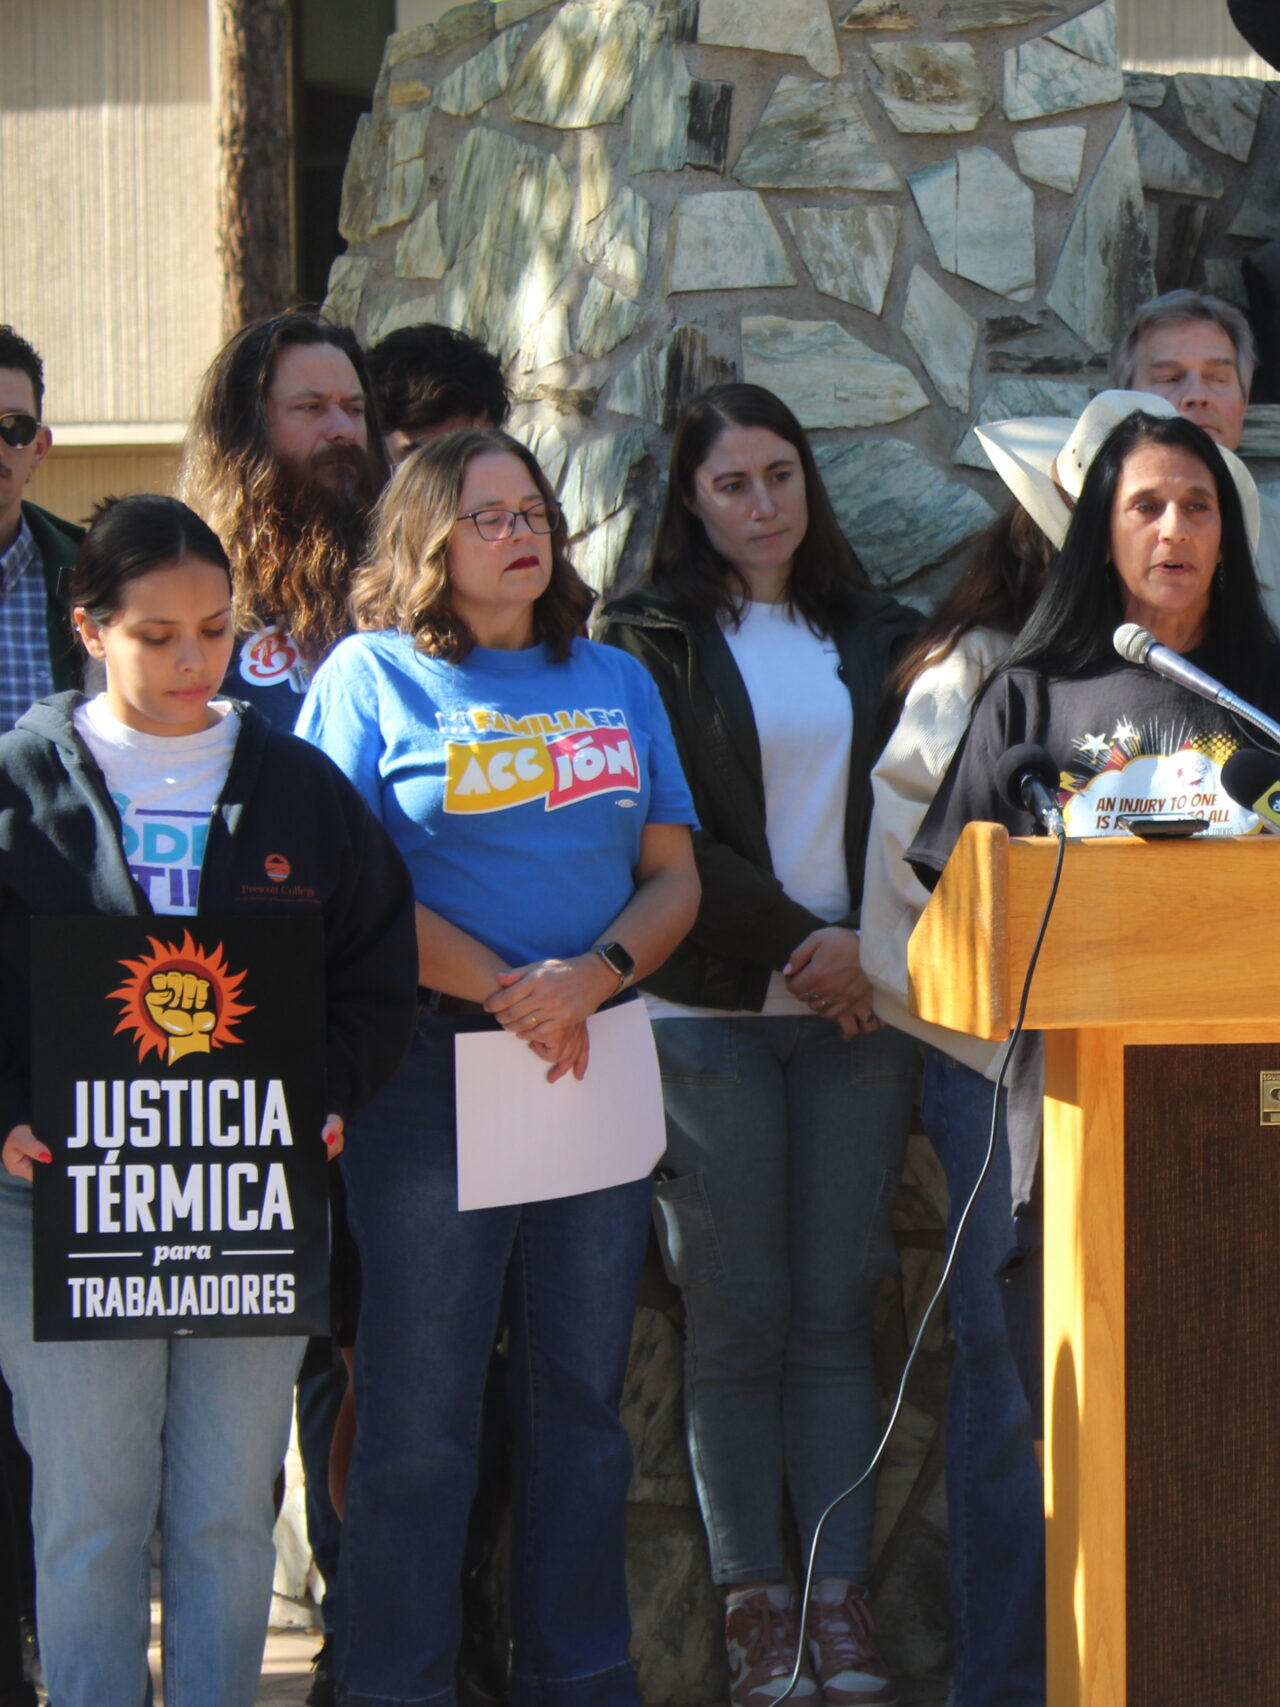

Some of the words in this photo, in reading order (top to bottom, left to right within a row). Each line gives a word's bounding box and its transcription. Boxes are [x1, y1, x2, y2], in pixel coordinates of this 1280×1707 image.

[470, 709, 594, 736] FAMILIA
[1095, 797, 1116, 812] AN
[1119, 797, 1167, 814] INJURY
[1170, 795, 1187, 811] TO
[1190, 793, 1218, 807] ONE
[1096, 815, 1111, 830] IS
[1208, 808, 1230, 823] ALL
[67, 1079, 294, 1149] JUSTICIA
[67, 1150, 295, 1234] TÉRMICA
[153, 1244, 212, 1267] para
[68, 1273, 295, 1318] TRABAJADORES
